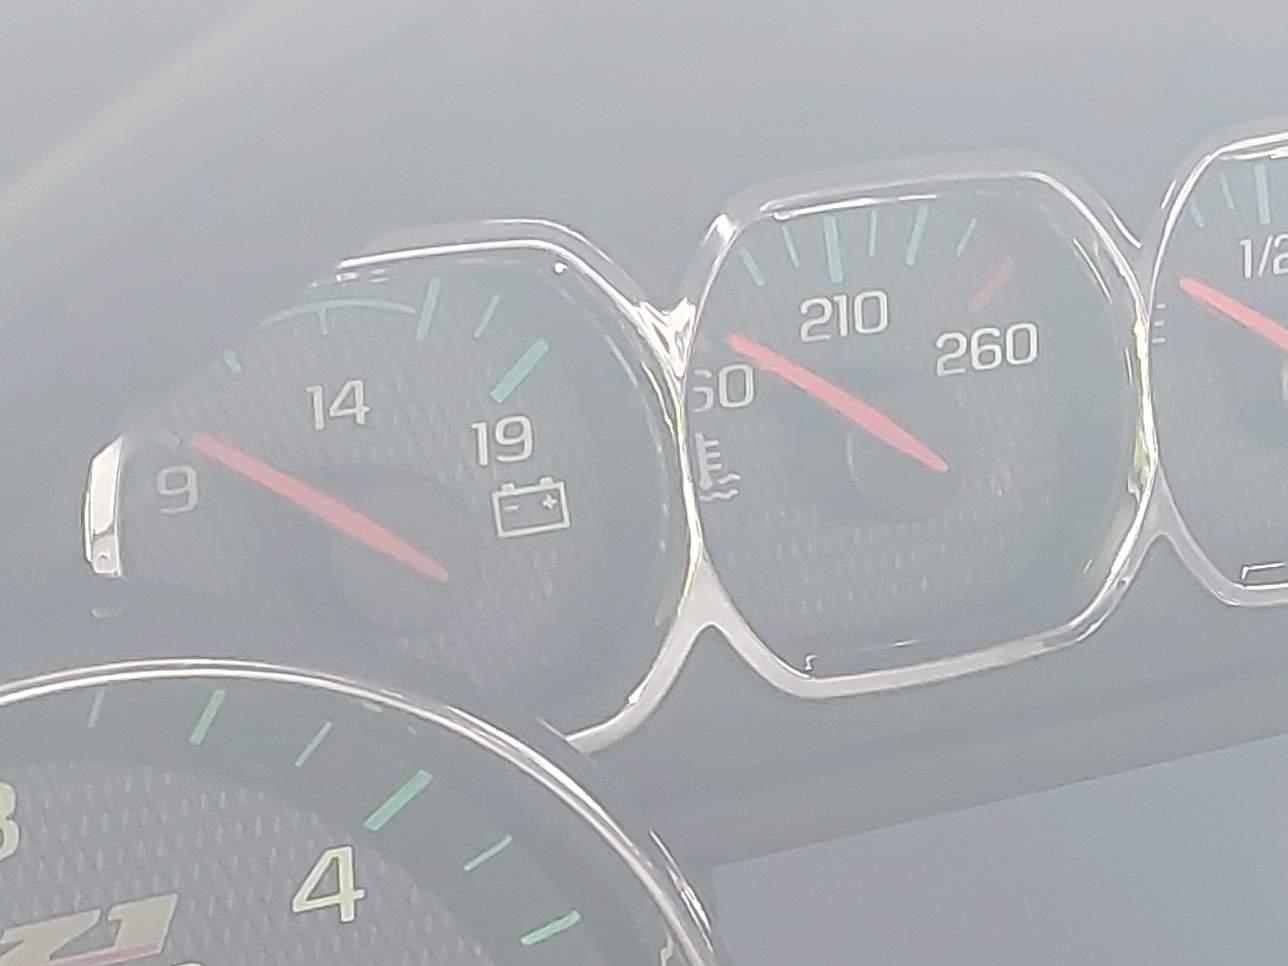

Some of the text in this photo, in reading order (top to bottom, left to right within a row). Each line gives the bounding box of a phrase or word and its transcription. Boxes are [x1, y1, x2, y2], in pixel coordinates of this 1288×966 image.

[800, 290, 888, 342] 210
[936, 323, 1038, 378] 260
[306, 379, 370, 430] 14
[471, 415, 533, 467] 19
[157, 465, 199, 514] 9
[292, 846, 366, 922] 4
